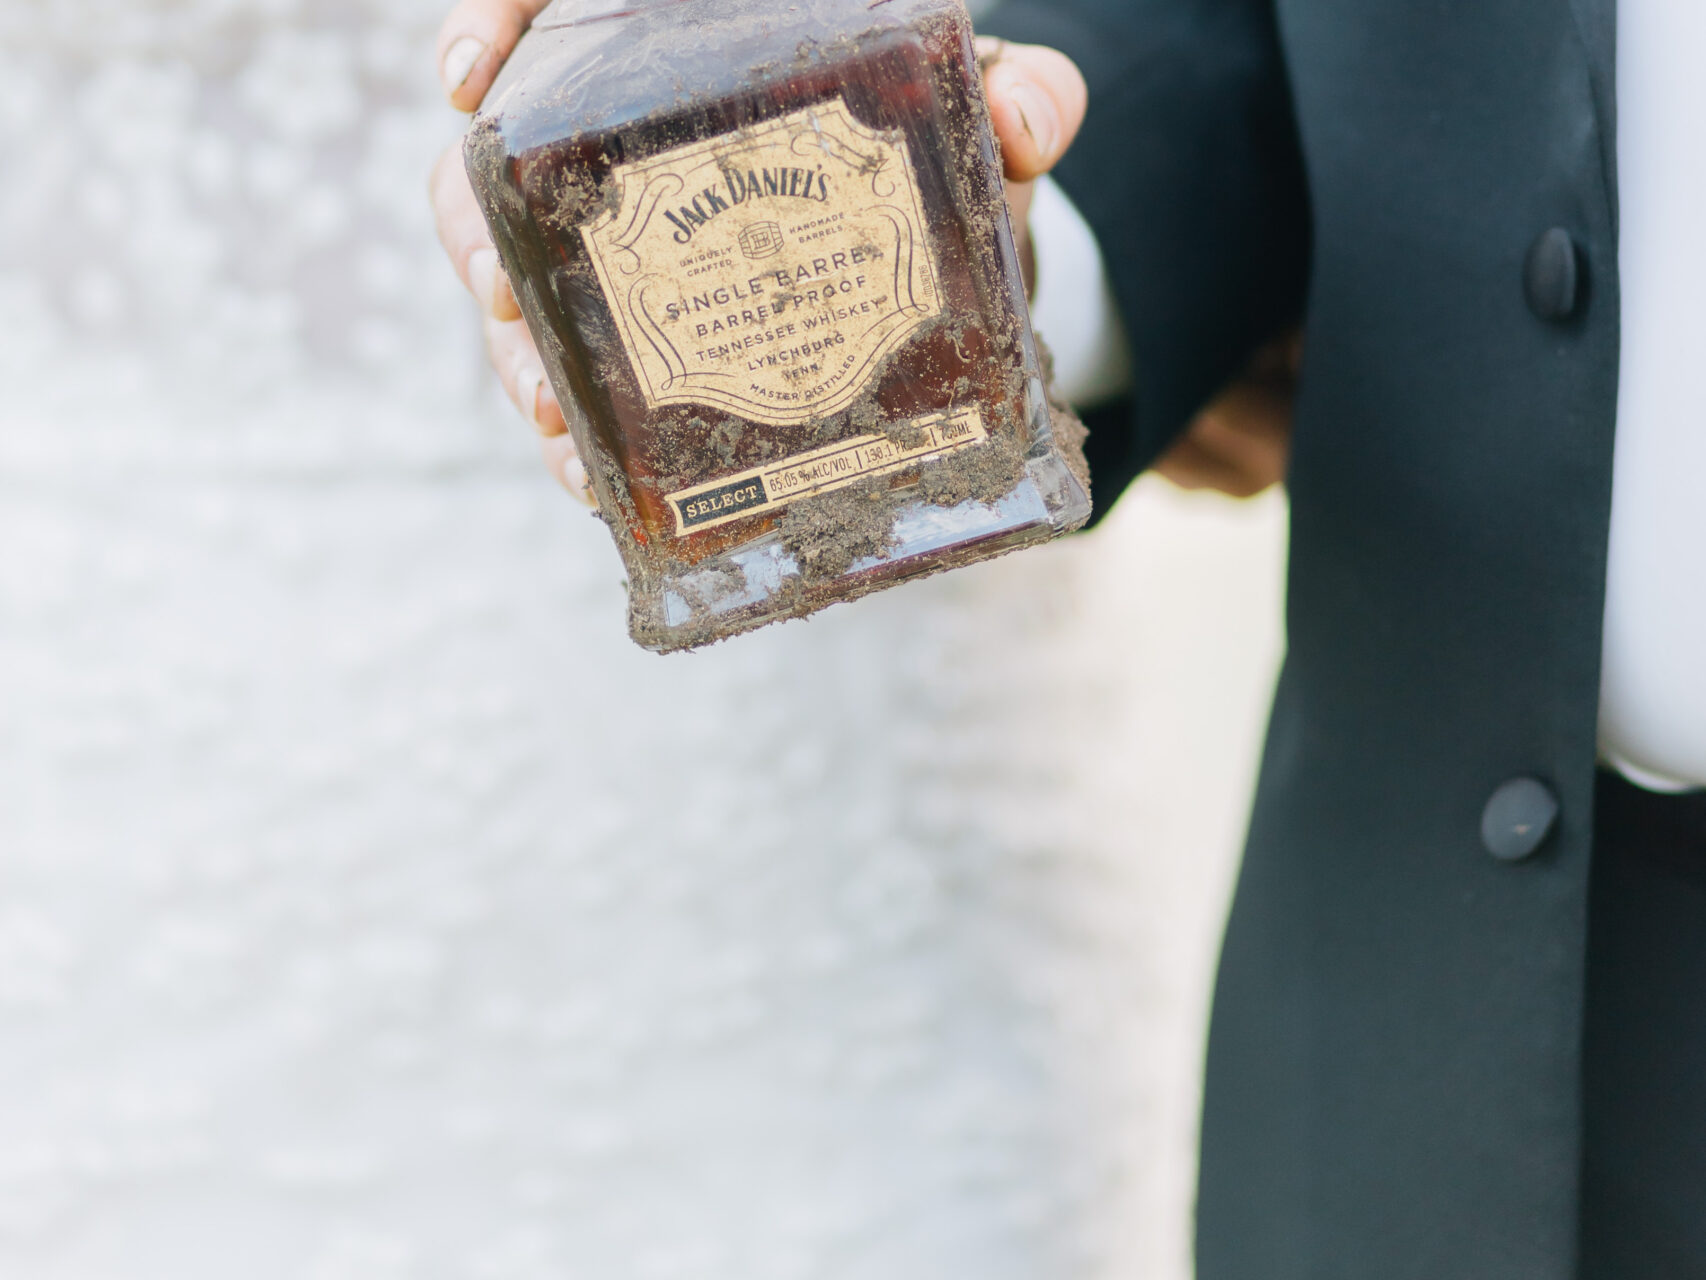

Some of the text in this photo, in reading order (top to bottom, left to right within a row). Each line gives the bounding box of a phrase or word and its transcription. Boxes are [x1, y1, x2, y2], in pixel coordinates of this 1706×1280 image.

[664, 184, 730, 244] JACK
[722, 163, 831, 202] DANIEL'S
[789, 212, 845, 234] HANDMADE
[798, 225, 844, 244] BARRELS
[679, 246, 733, 267] UNIQUELY
[687, 258, 733, 277] CRAFTED
[666, 246, 884, 317] SINGLE BARRE
[793, 275, 867, 309] PROOF
[696, 298, 881, 362] TENNESSEE WHISKEY
[747, 332, 845, 371] LYNCHBURG
[750, 354, 856, 401] MASTER DISTILLED
[769, 471, 799, 493] 65.05
[812, 455, 853, 479] ALC/VOL
[686, 484, 759, 520] SELECT
